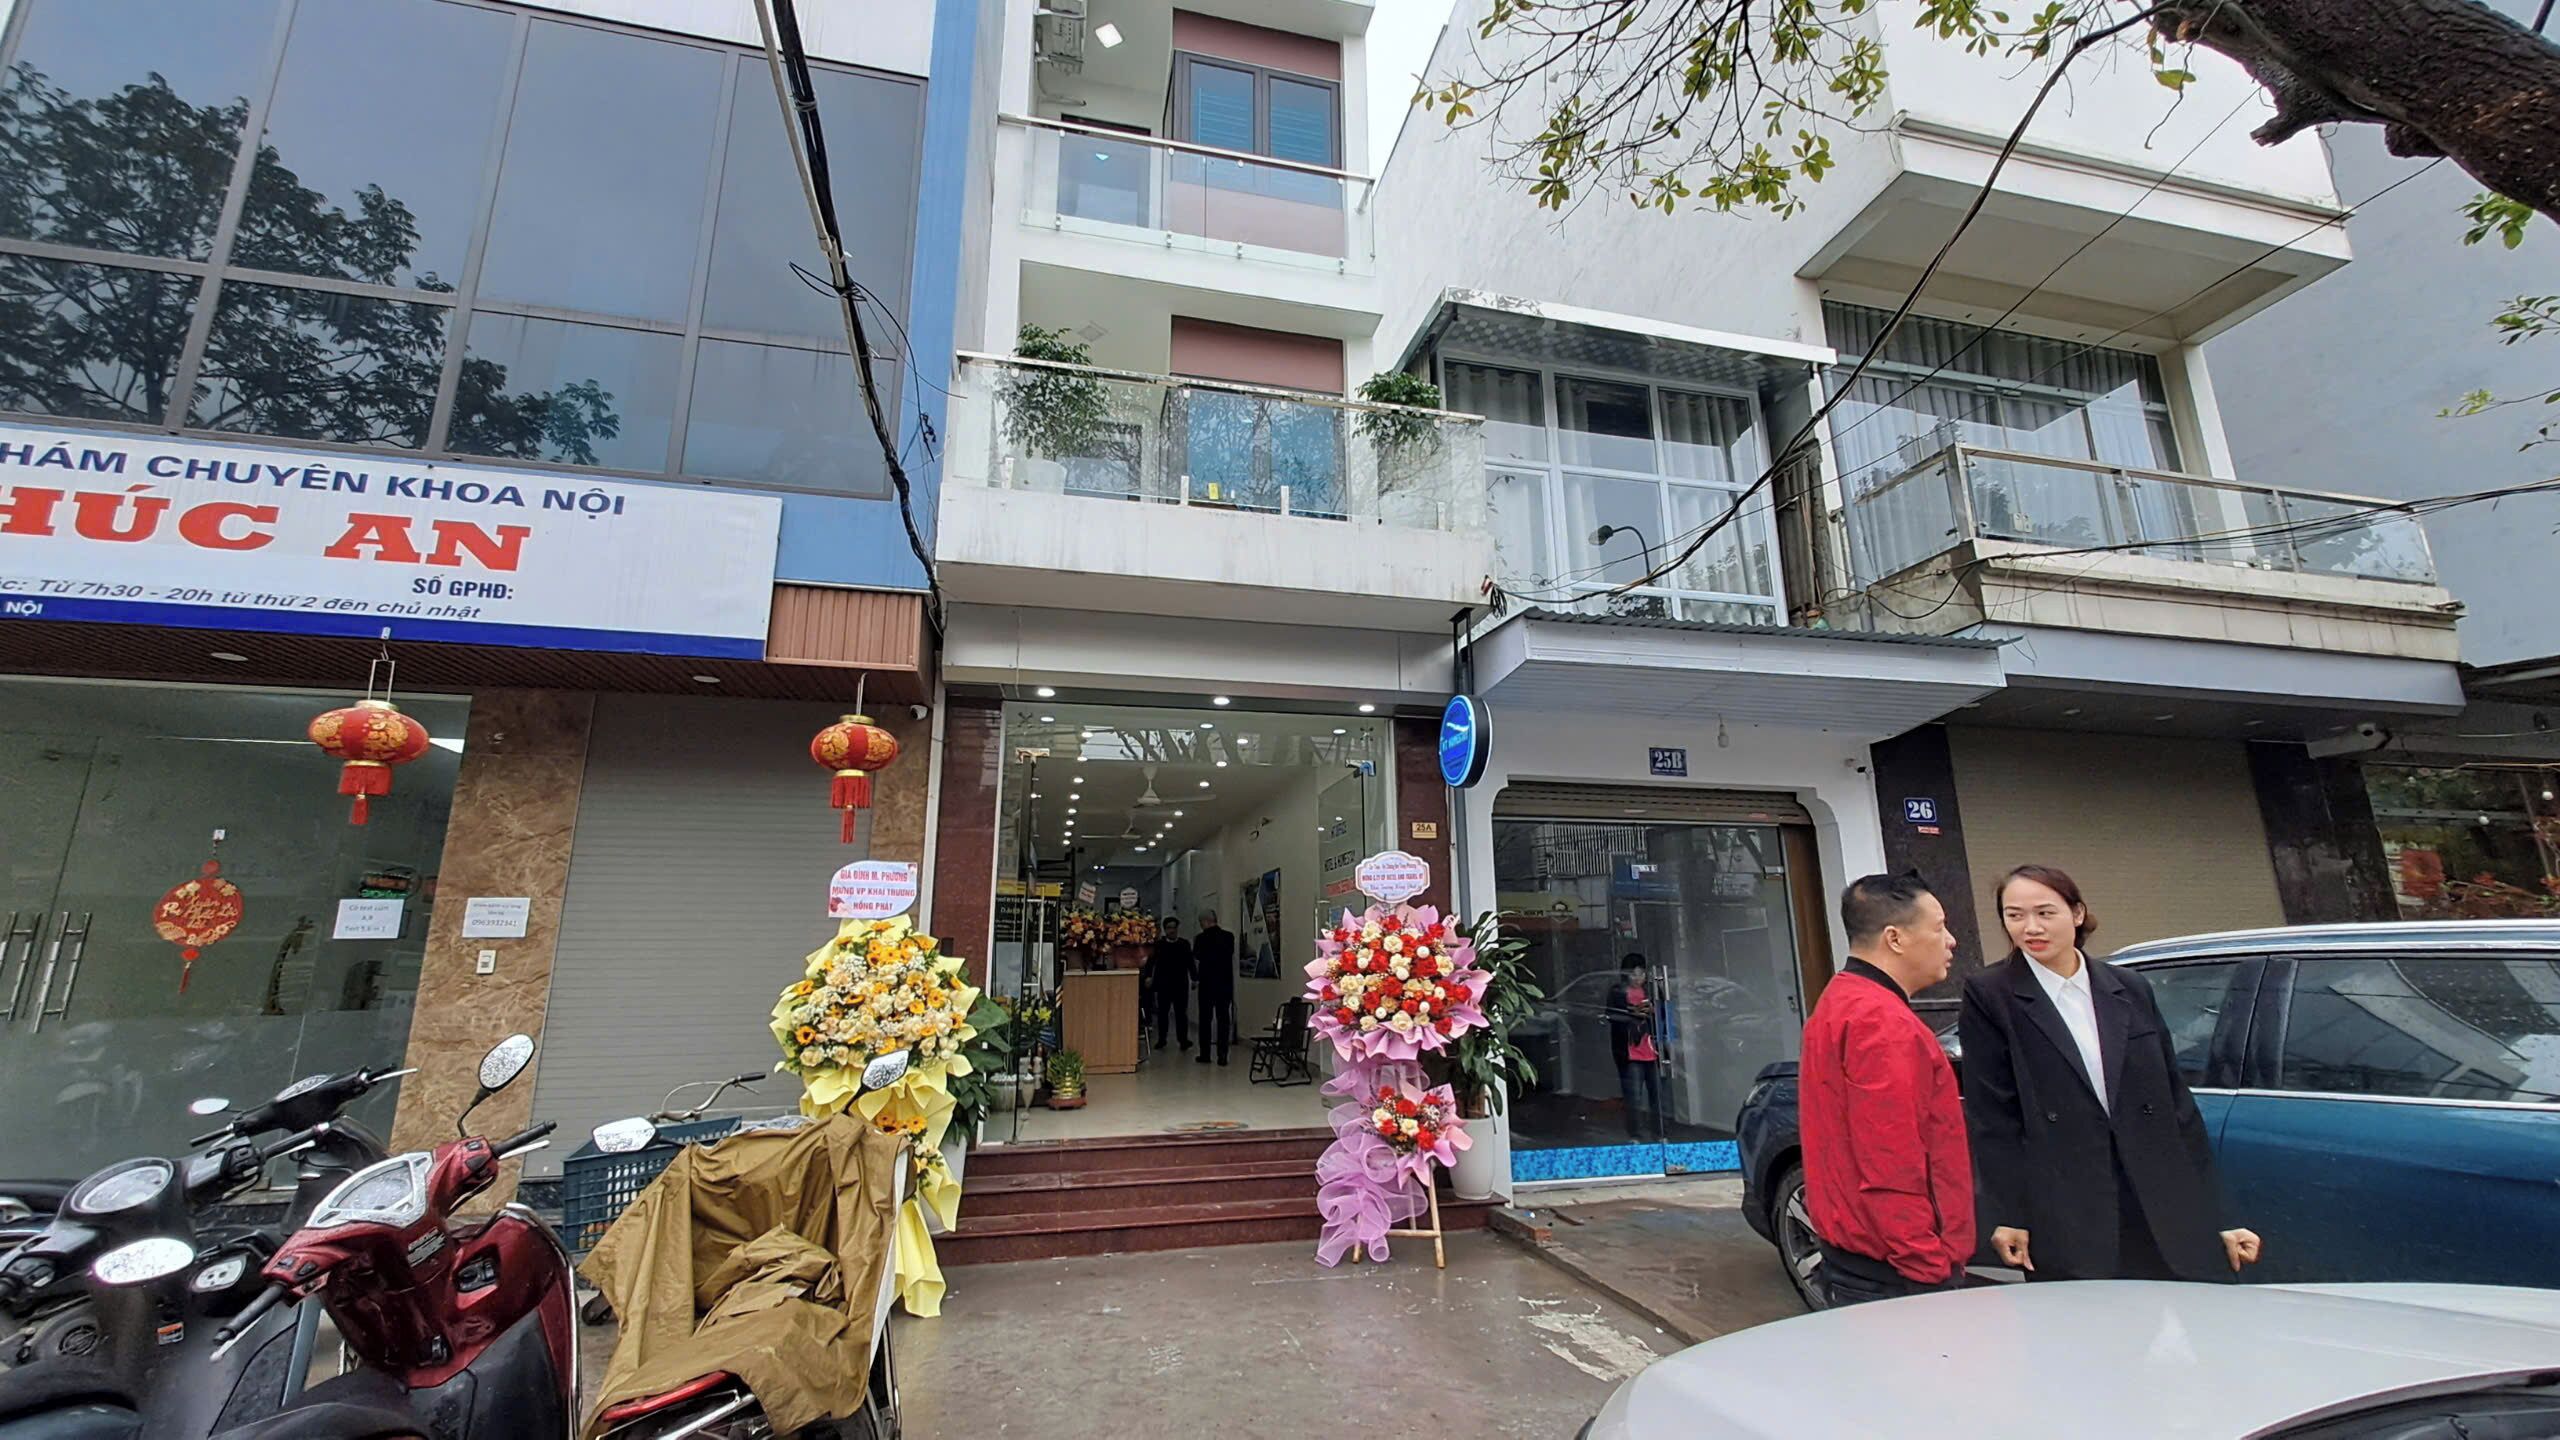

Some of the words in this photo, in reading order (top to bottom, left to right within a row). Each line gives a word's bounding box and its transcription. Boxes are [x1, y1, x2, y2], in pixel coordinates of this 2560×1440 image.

[147, 455, 369, 494] CHUYÊN
[386, 475, 526, 508] KHOA
[542, 487, 625, 519] NỘI
[323, 512, 532, 572] AN
[412, 574, 445, 595] SỐ
[449, 580, 514, 600] GPHĐ:
[0, 576, 28, 590] c:
[39, 579, 72, 593] Từ
[78, 581, 144, 598] 7h30
[165, 587, 213, 602] 20h
[221, 591, 251, 604] từ
[253, 592, 300, 607] thứ
[300, 596, 318, 608] 2
[376, 599, 422, 615] chủ
[426, 604, 482, 620] nhật
[6, 600, 44, 617] NỘI
[1654, 751, 1683, 769] 25B
[1908, 801, 1933, 819] 26
[1415, 823, 1433, 832] 25A
[857, 887, 866, 895] VP
[867, 887, 885, 896] KHAI
